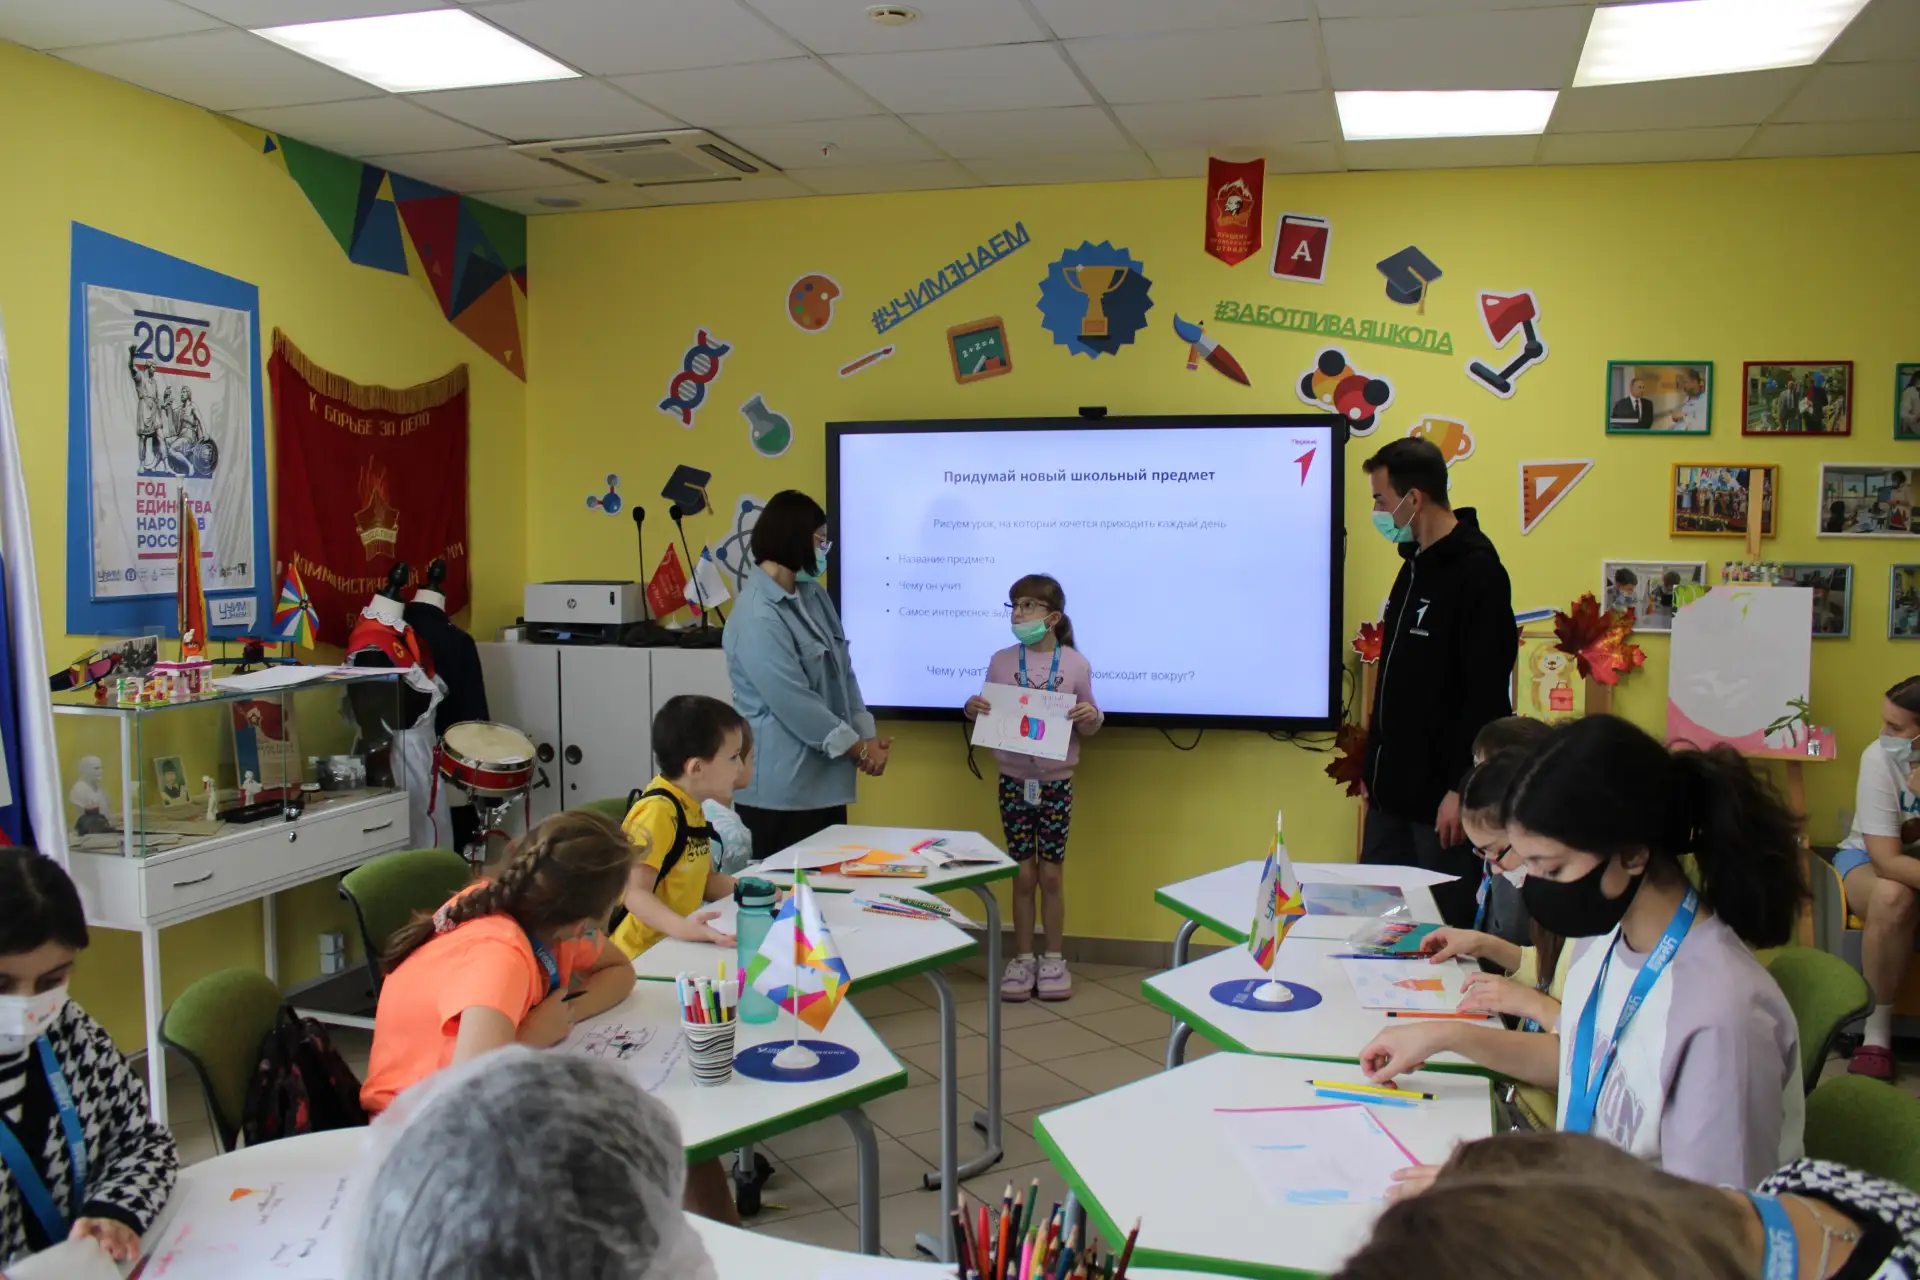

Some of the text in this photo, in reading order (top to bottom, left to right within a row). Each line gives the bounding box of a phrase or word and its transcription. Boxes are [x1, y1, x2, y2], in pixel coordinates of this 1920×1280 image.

[1214, 300, 1453, 356] #ЗАБОТЛИВАЯШКОЛА
[134, 320, 211, 368] 2026
[309, 391, 430, 436] К БОРЬБЕ ЗА ДЕЛО
[944, 468, 1216, 485] Придумай новый школьный предмет
[136, 481, 167, 499] ГОД
[136, 499, 212, 516] ЕДИНТВА
[136, 517, 206, 531] НАРОВ
[933, 518, 969, 530] Рисуем
[999, 520, 1011, 528] на
[1014, 517, 1057, 531] который
[1059, 520, 1098, 529] хочется
[1100, 520, 1155, 530] приходить
[1157, 517, 1198, 530] каждый
[1199, 520, 1228, 530] день
[898, 554, 995, 566] Название предмета
[898, 580, 961, 592] Чему он учит
[898, 606, 930, 617] Самое
[931, 608, 990, 619] интересное
[926, 666, 955, 679] Чему
[1091, 670, 1147, 683] оисходит
[1151, 670, 1196, 684] вокруг?
